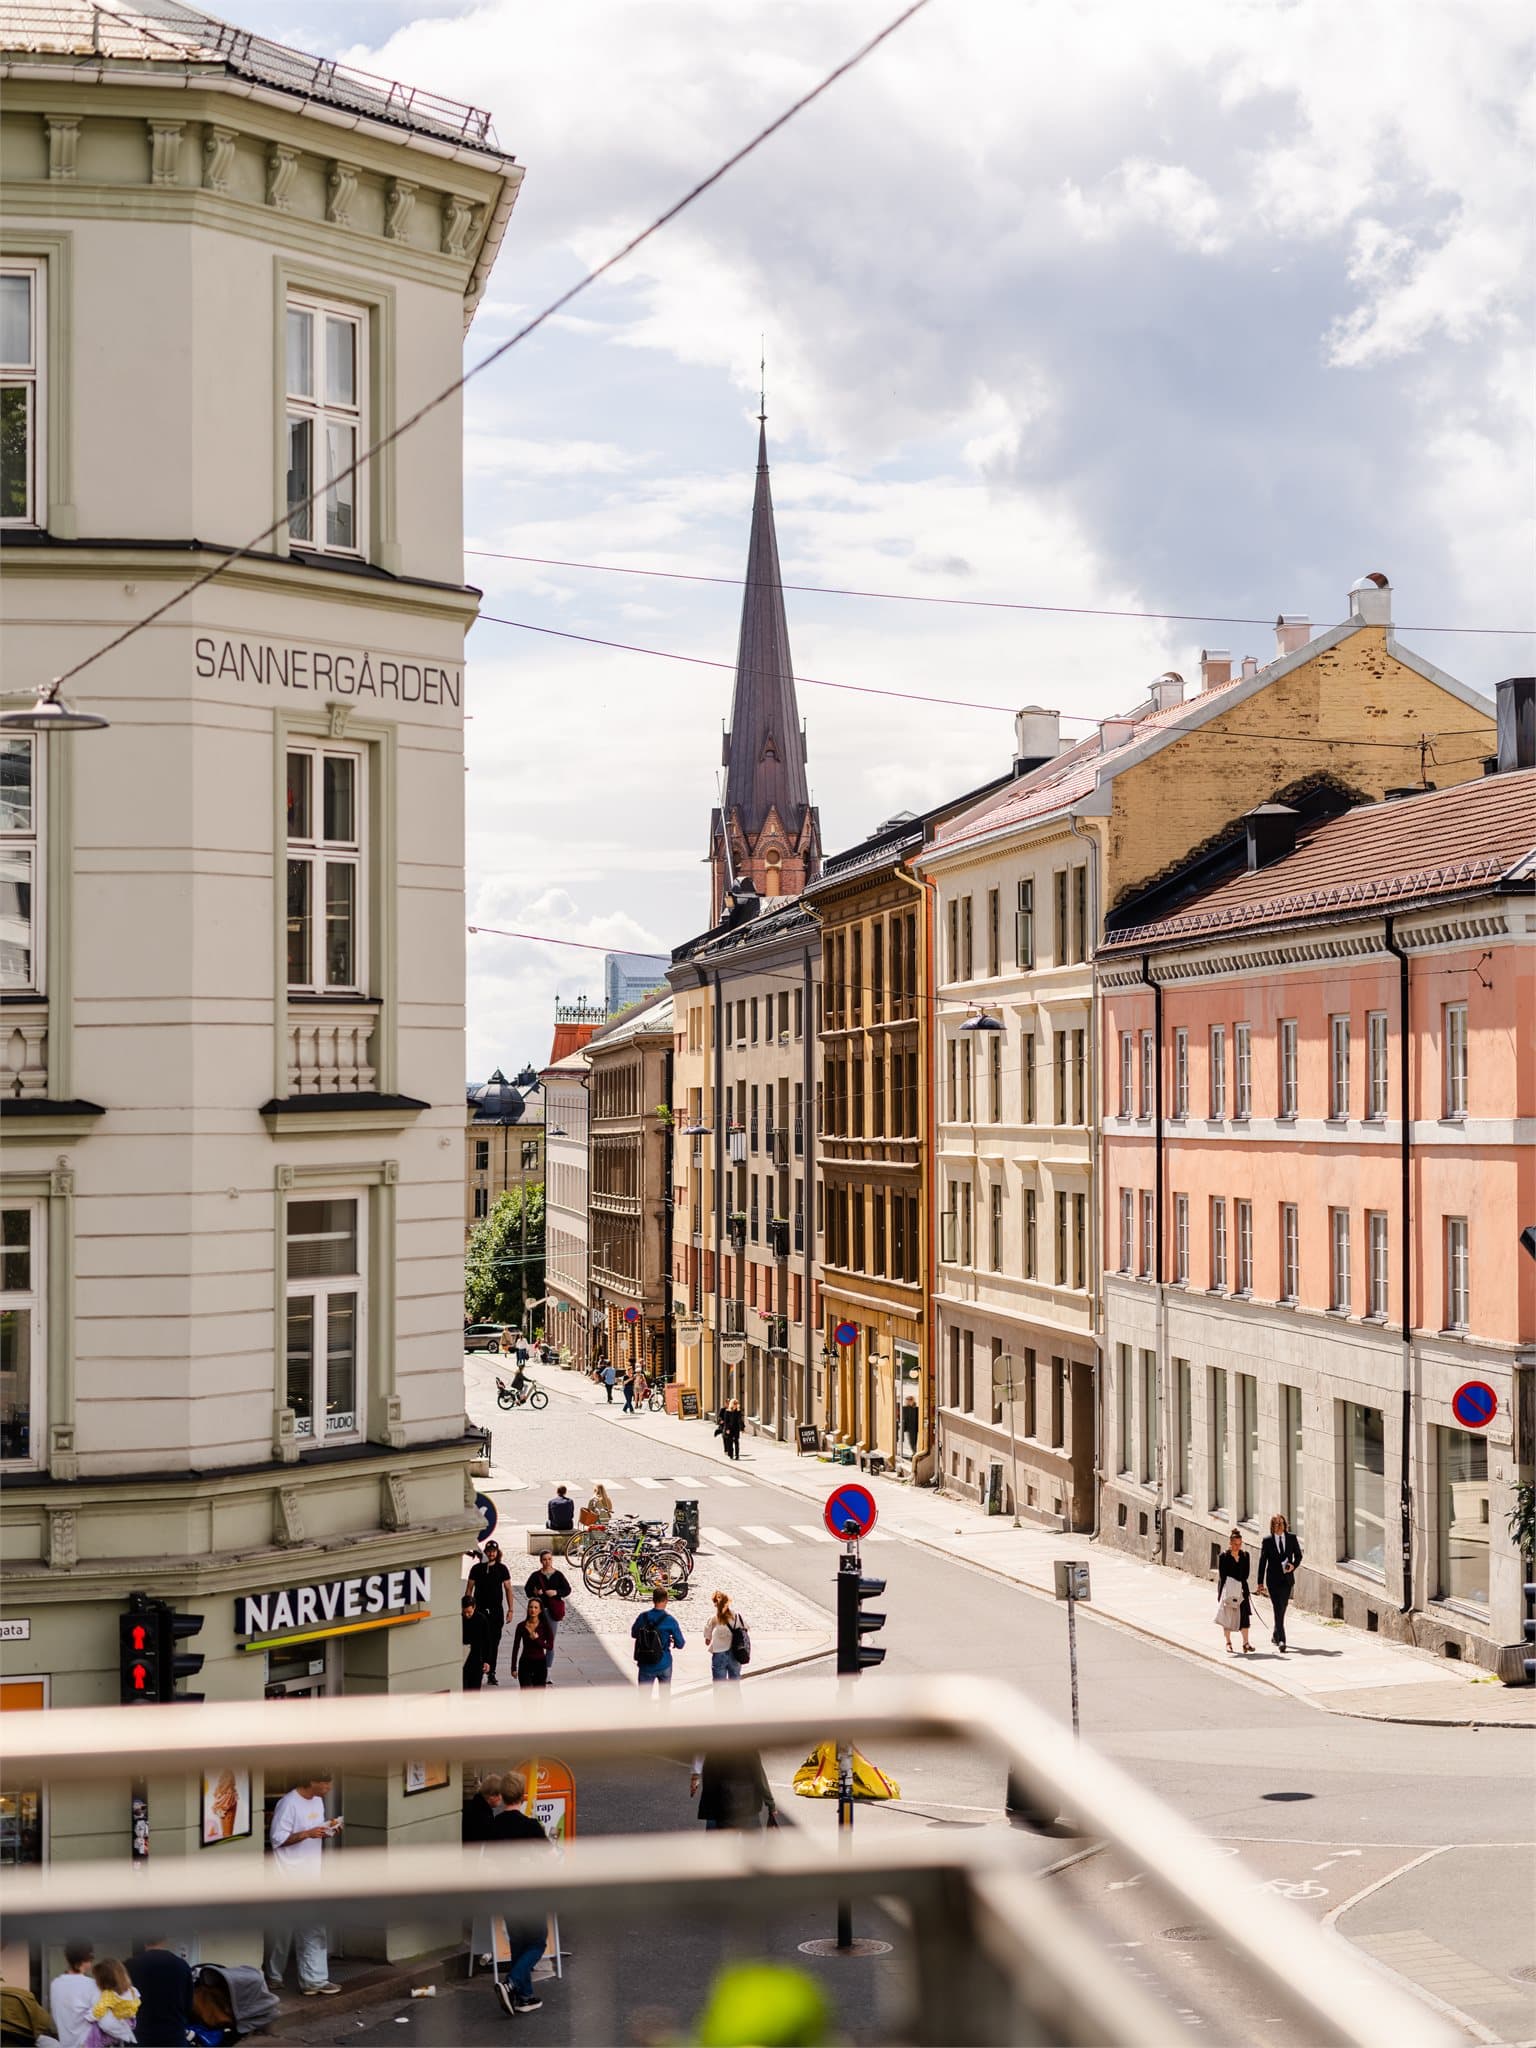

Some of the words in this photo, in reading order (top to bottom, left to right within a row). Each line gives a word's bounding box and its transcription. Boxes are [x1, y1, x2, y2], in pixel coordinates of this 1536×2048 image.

[195, 638, 460, 706] SANNERGÅRDEN
[244, 1566, 432, 1635] NARVESEN
[536, 1803, 554, 1812] rap
